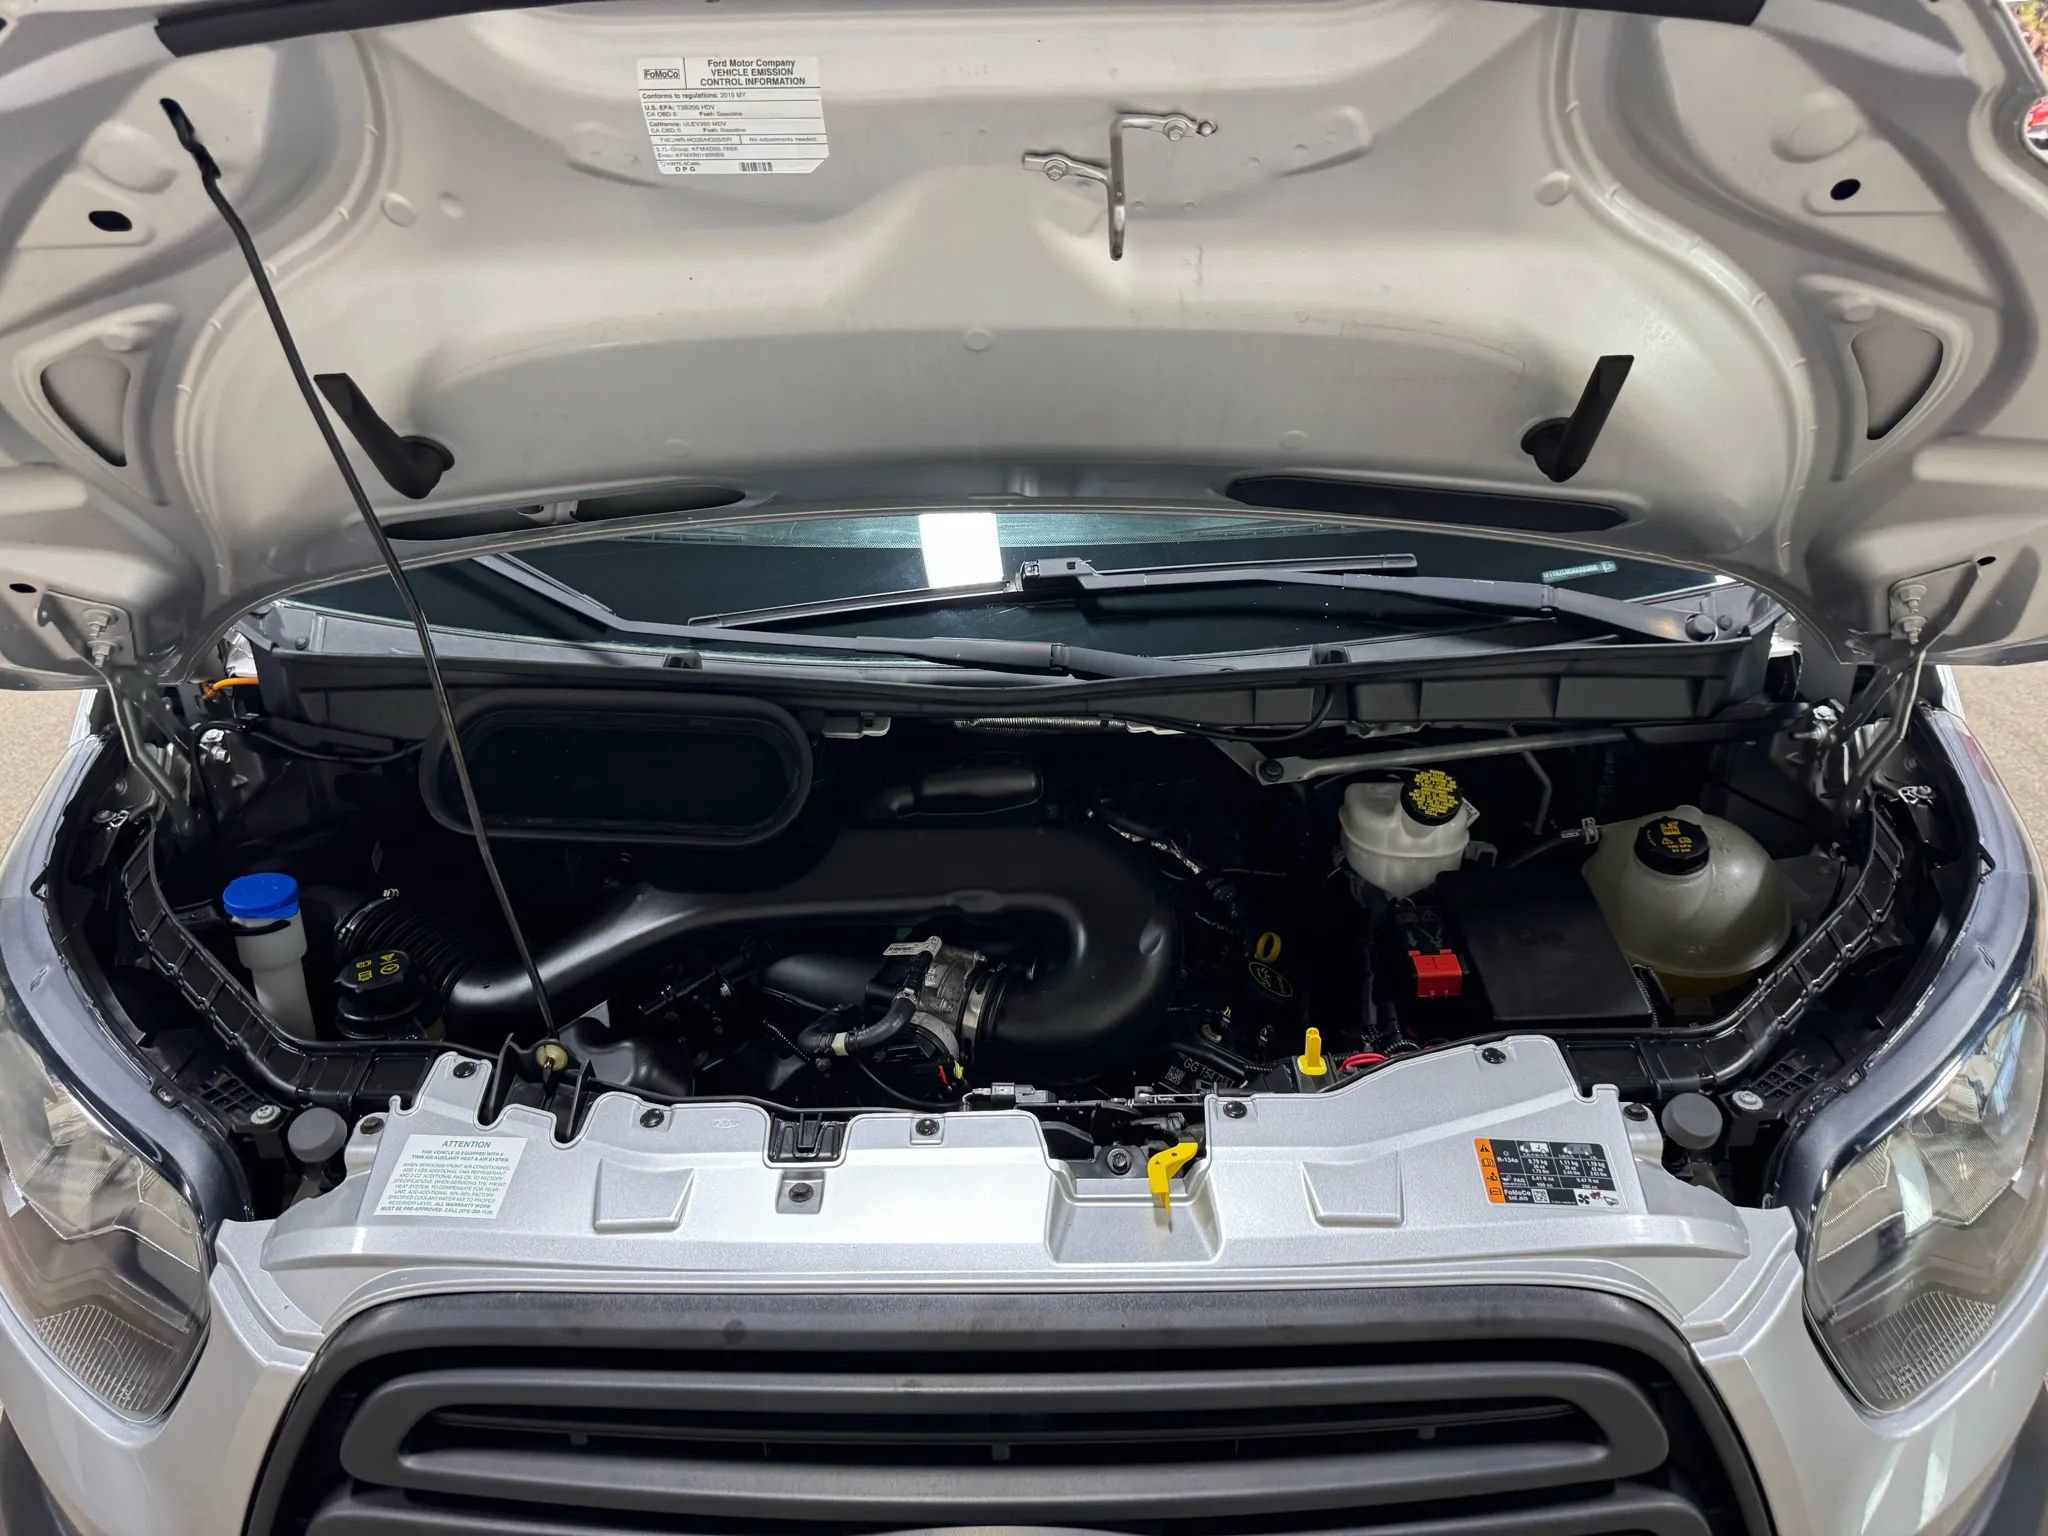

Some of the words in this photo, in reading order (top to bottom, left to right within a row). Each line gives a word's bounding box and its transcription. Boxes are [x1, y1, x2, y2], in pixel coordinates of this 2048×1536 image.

[708, 59, 727, 68] Ford
[730, 59, 754, 68] Motor
[756, 58, 796, 68] Company
[645, 70, 679, 78] FoMoCo
[710, 68, 749, 76] VEHICLE
[751, 68, 794, 76] EMISSION
[700, 78, 744, 86] CONTROL
[745, 77, 806, 86] INFORMATION
